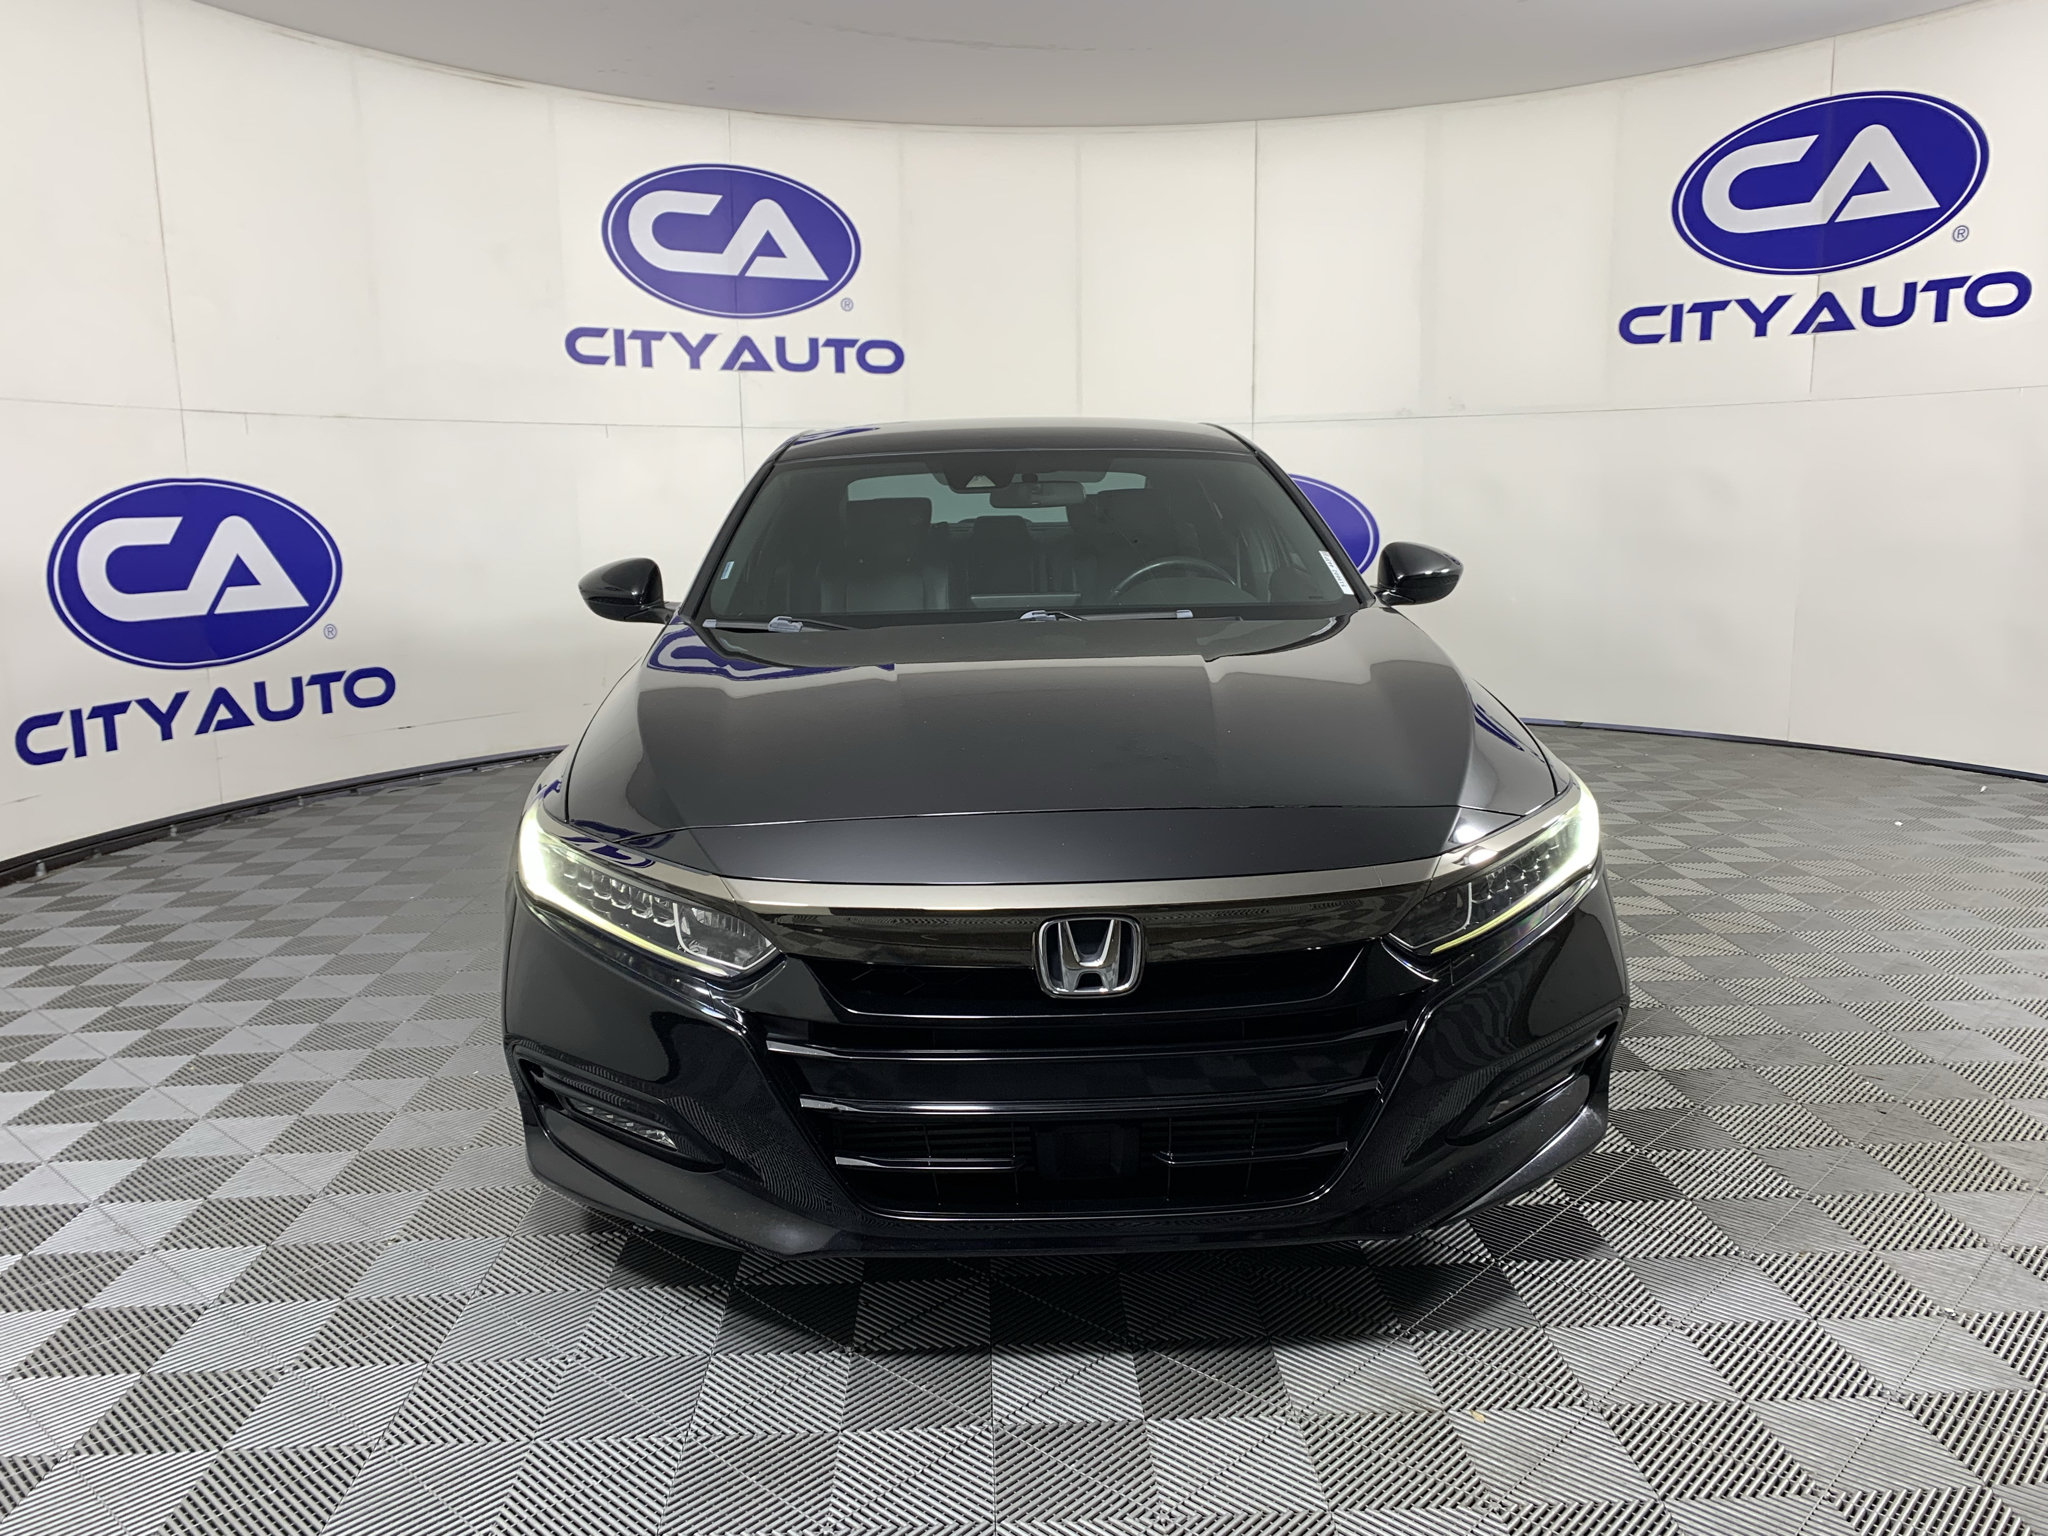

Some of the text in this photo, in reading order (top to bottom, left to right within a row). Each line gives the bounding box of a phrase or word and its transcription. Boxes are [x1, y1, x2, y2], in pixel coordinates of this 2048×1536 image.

[1702, 124, 1941, 233] CA
[629, 190, 829, 281] CA
[565, 327, 905, 374] CITY AUTO
[1618, 271, 2032, 345] CITY AUTO
[77, 515, 309, 622] CA
[15, 667, 396, 765] CITY AUTO
